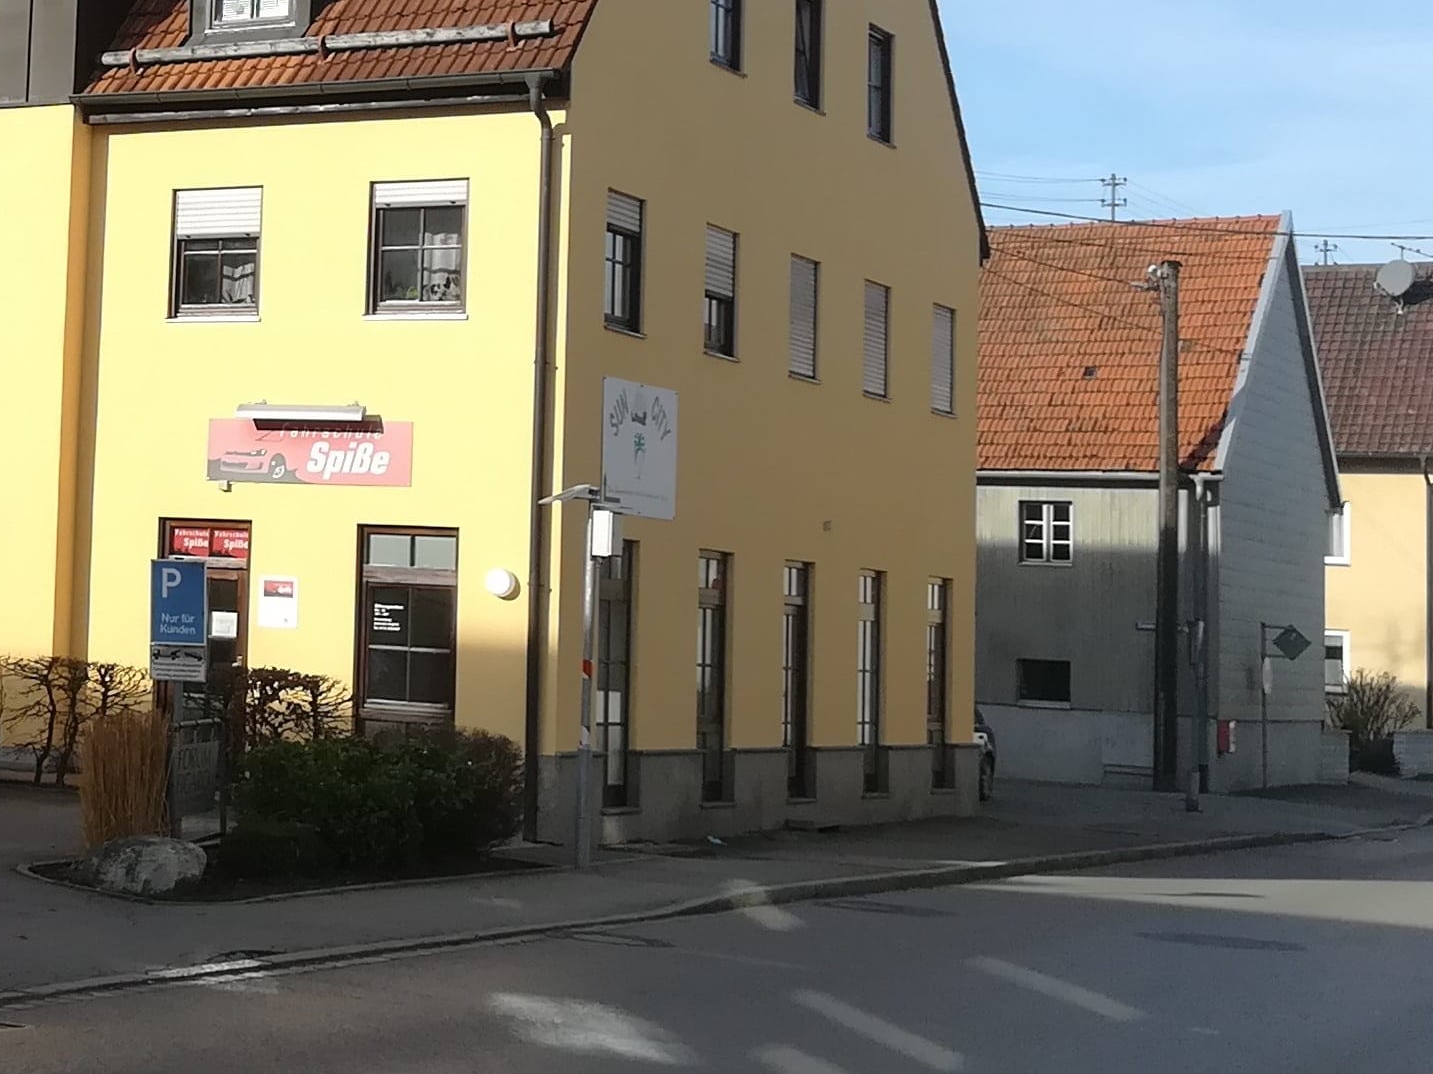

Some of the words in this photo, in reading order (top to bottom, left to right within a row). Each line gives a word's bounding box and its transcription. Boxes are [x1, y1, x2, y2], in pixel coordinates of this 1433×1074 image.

[609, 388, 629, 437] SUN
[651, 396, 671, 440] CITY
[306, 441, 391, 480] Spiße
[161, 567, 182, 598] P
[160, 624, 196, 635] Kunden
[161, 612, 179, 623] Nur
[182, 613, 195, 623] für
